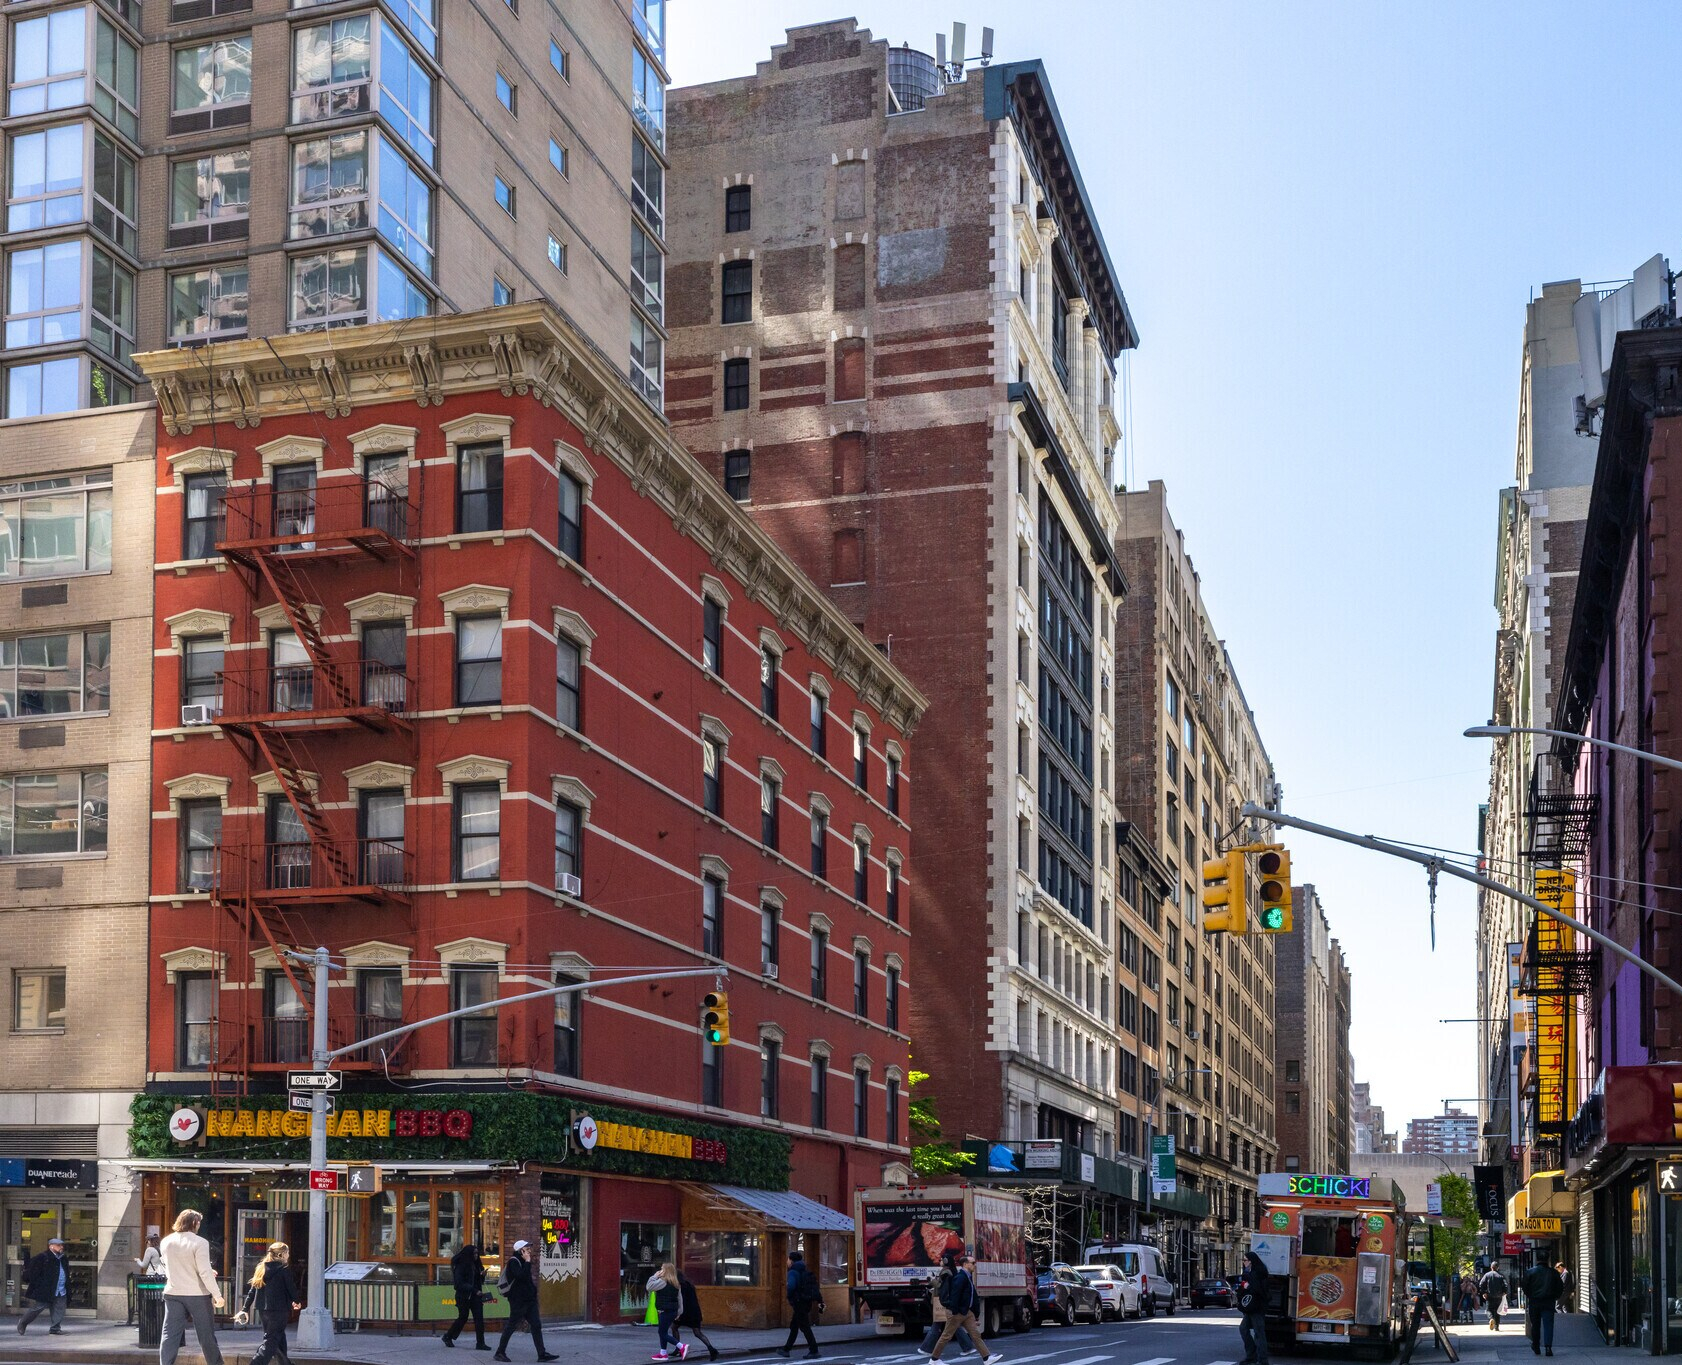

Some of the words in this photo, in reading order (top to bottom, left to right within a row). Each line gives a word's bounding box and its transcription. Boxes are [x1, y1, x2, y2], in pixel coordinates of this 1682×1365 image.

[1546, 876, 1565, 885] NEW
[1538, 884, 1573, 894] DRAGON
[1547, 894, 1564, 903] TOY
[296, 1098, 309, 1106] ONE
[395, 1110, 473, 1140] BBQ
[693, 1137, 727, 1168] BBQ
[1488, 1184, 1499, 1216] FOCUS
[542, 1219, 553, 1231] Yes
[554, 1219, 570, 1232] BBQ
[1516, 1219, 1541, 1229] DRAGON
[1543, 1219, 1555, 1229] TOY
[547, 1232, 557, 1244] Yes
